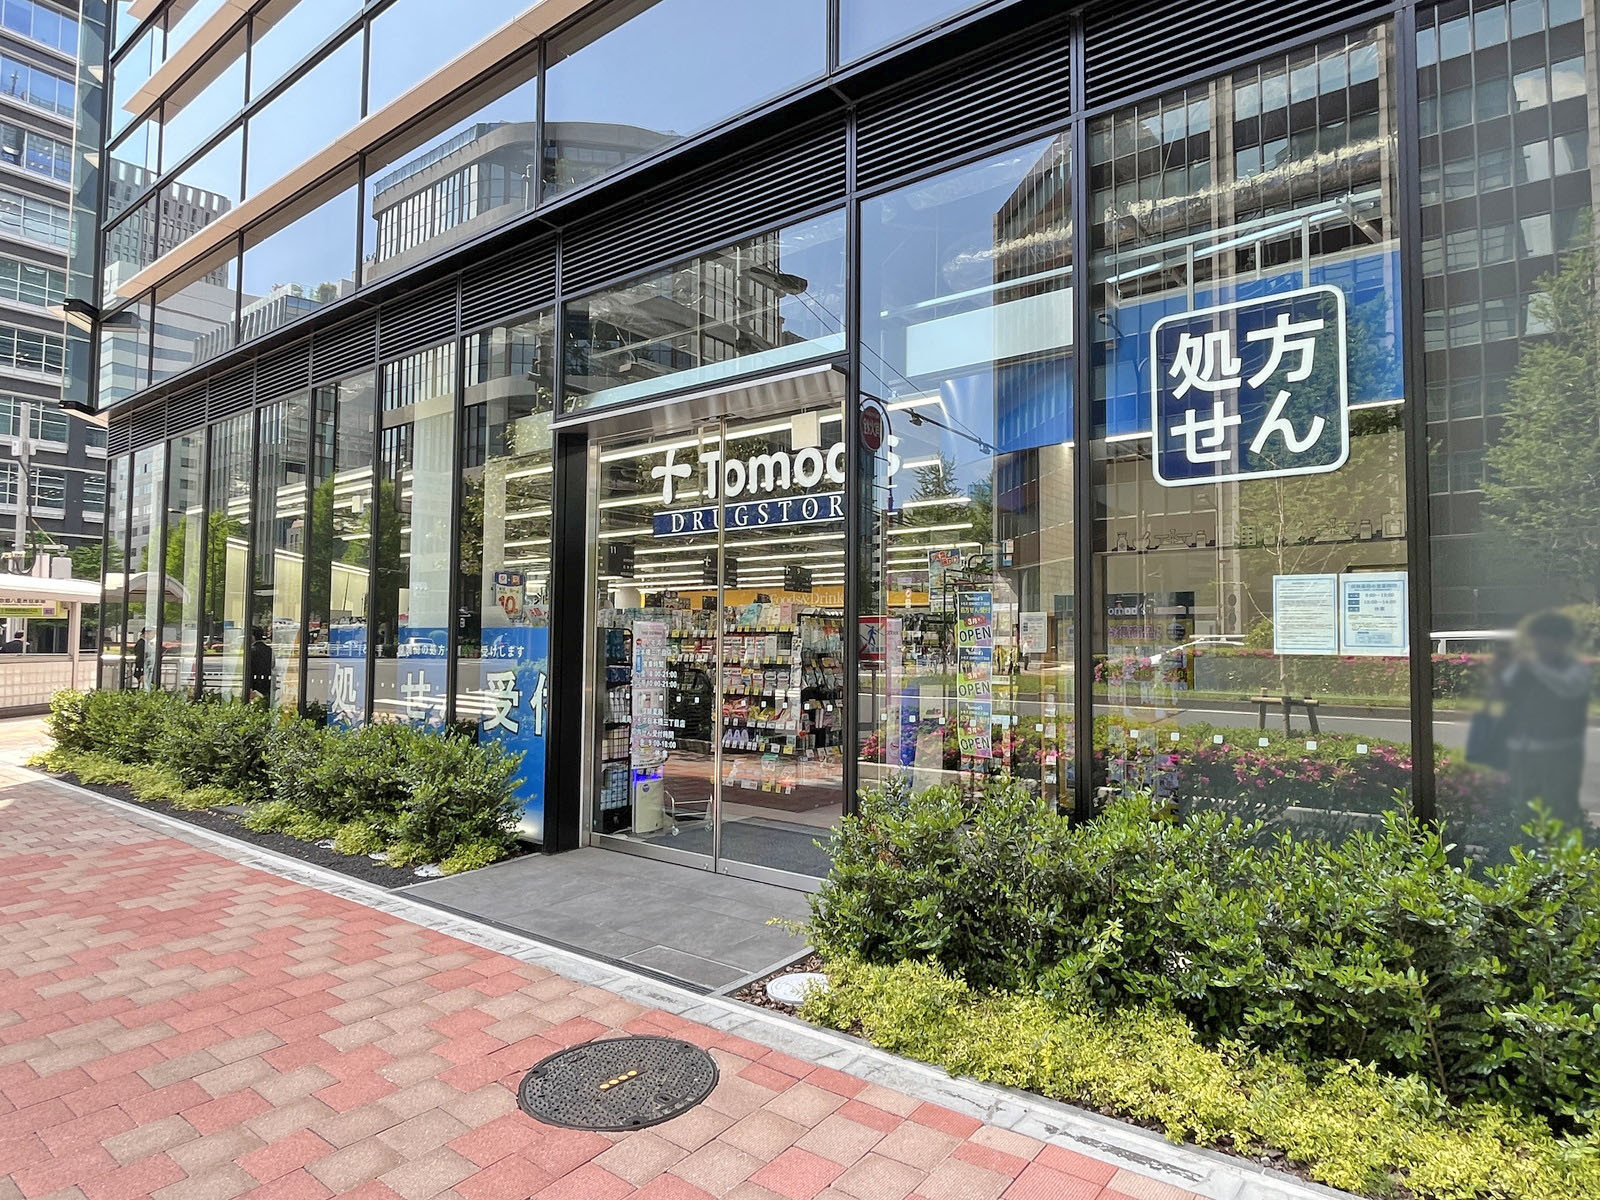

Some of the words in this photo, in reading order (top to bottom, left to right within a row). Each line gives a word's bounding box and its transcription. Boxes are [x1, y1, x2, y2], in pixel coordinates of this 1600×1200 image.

[1168, 313, 1325, 400] 処方
[1170, 389, 1326, 464] せん
[699, 434, 900, 499] Tomo
[671, 495, 845, 533] DRUGSTOR
[1107, 603, 1146, 616] omod's
[959, 625, 992, 643] OPEN
[958, 680, 991, 697] OPEN
[960, 736, 990, 750] OPEN
